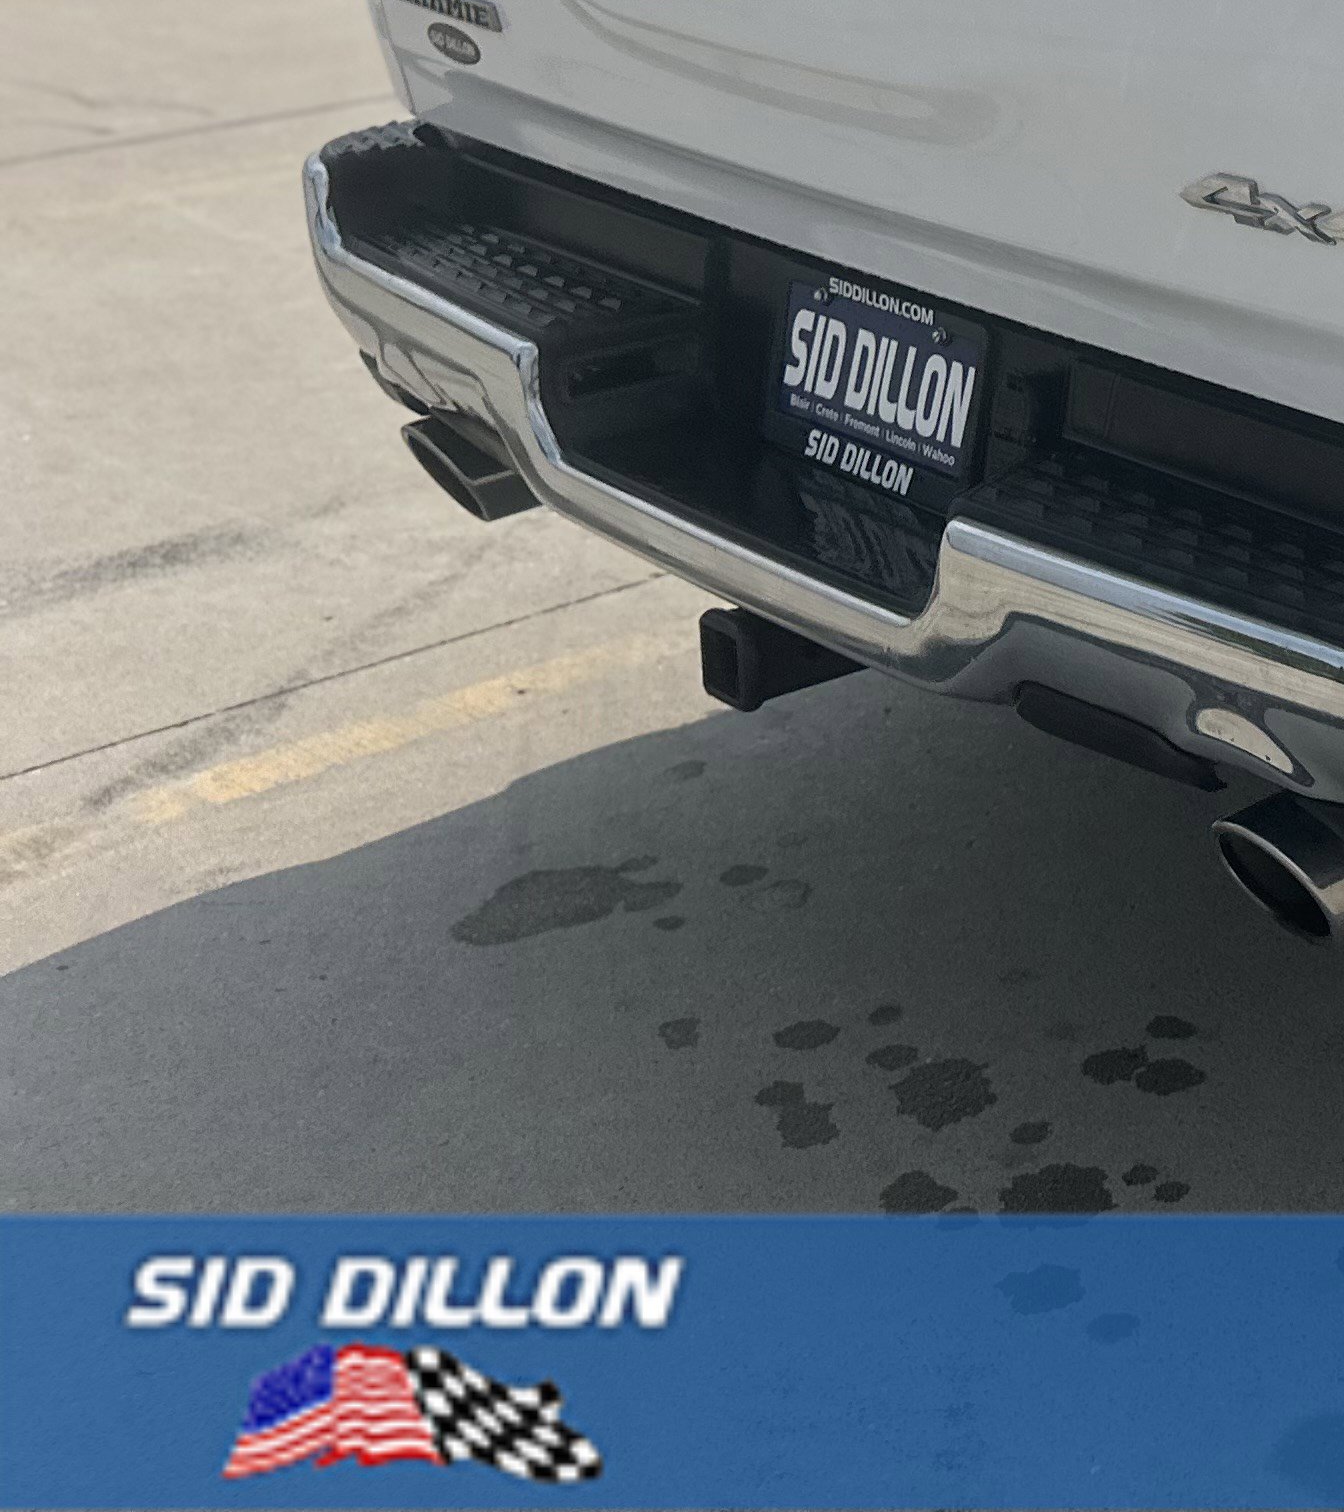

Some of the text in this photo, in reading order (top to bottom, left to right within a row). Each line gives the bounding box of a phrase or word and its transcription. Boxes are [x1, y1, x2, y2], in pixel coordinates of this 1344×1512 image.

[829, 277, 933, 325] SIDDILLON.COM
[783, 308, 976, 448] SID DILLON
[804, 428, 914, 496] SID DILLON
[844, 413, 880, 437] Fremont
[885, 429, 917, 452] Lincoln
[922, 443, 955, 467] Wahoo
